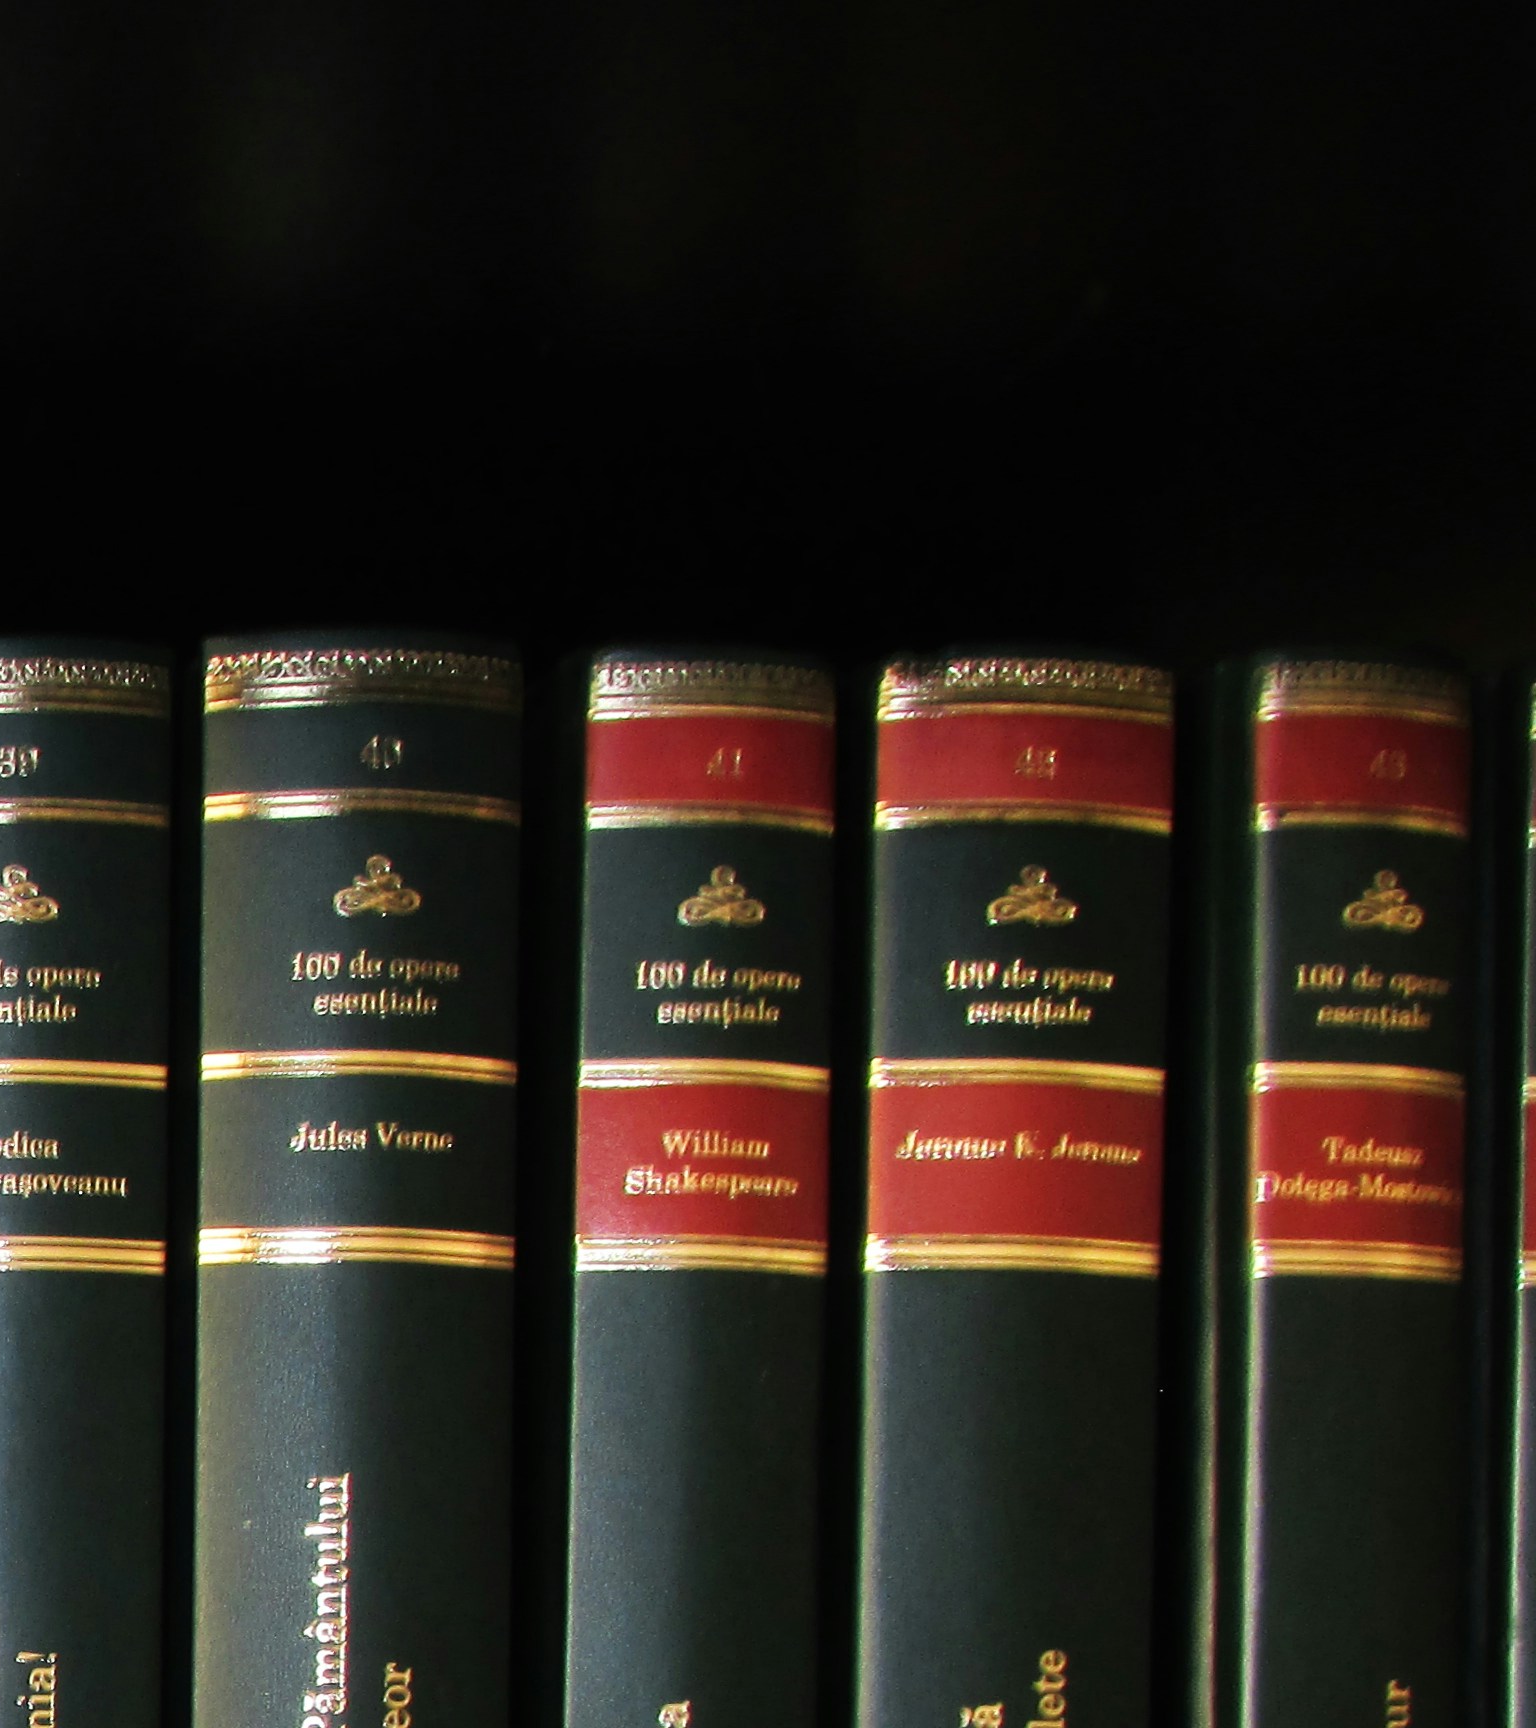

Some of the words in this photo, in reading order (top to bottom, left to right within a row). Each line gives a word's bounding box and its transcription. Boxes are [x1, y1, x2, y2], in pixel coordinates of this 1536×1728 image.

[290, 1121, 368, 1152] Jules
[376, 1122, 453, 1150] Verne
[664, 1129, 771, 1158] William
[1322, 1136, 1422, 1166] Tadeusz
